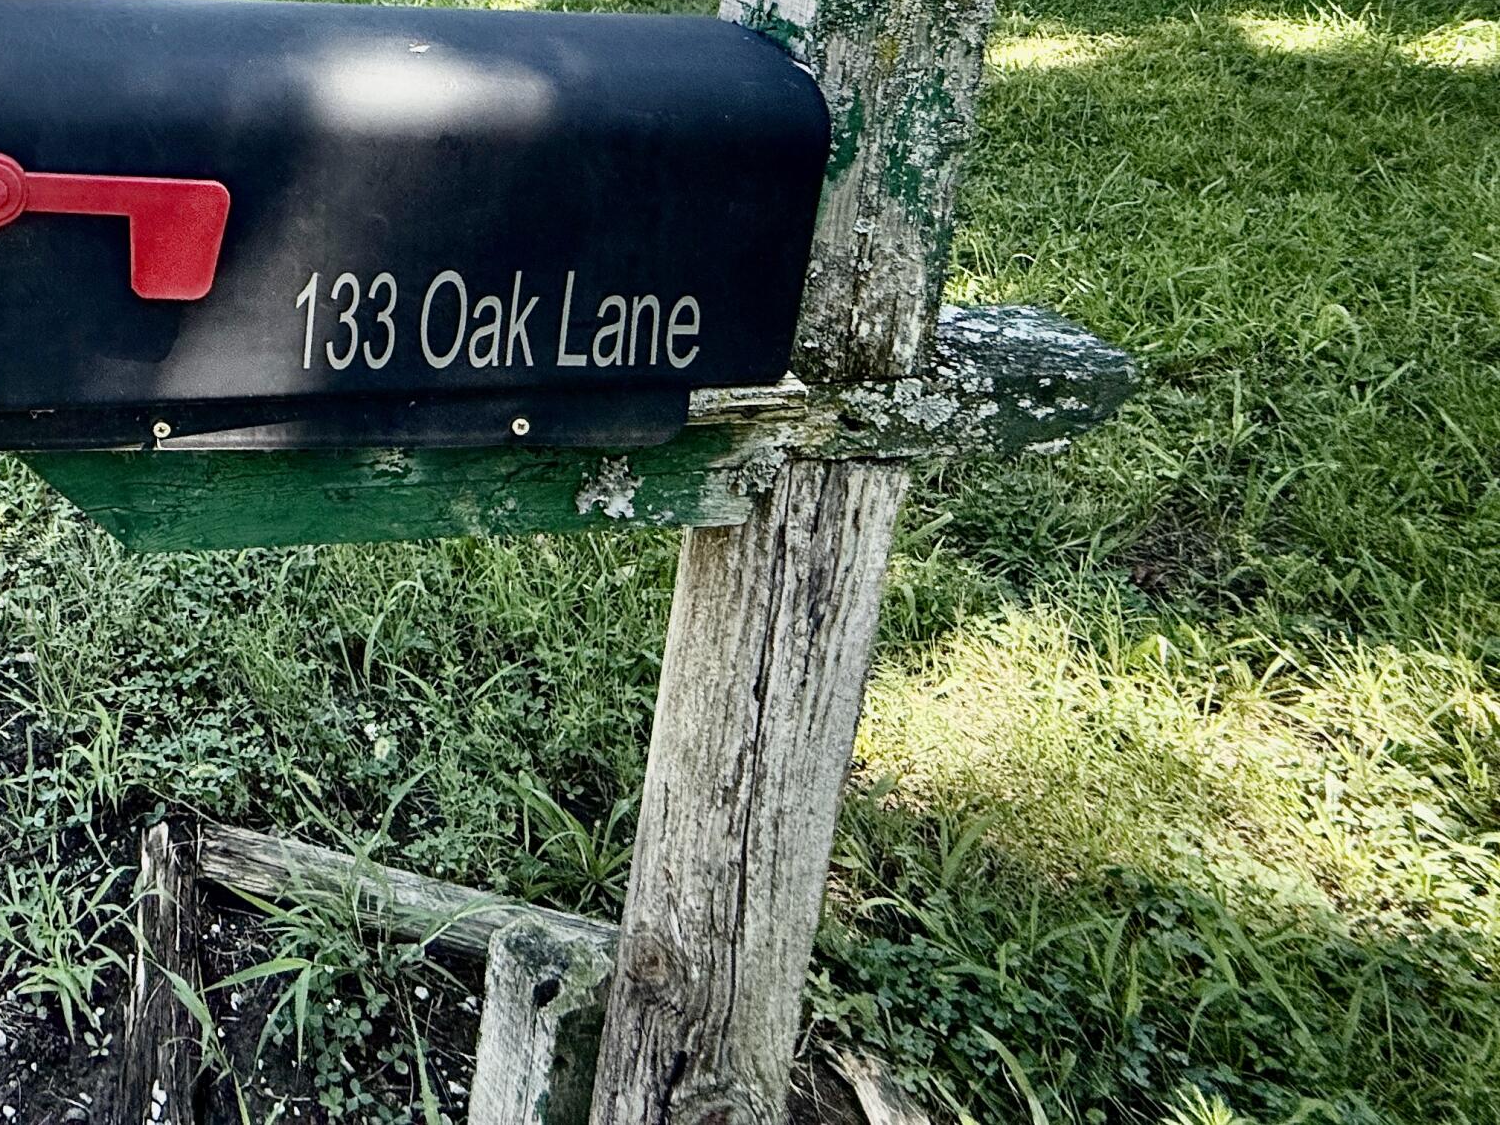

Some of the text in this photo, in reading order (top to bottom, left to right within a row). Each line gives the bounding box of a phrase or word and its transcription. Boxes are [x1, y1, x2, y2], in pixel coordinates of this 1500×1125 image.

[295, 270, 701, 370] 133 Oak Lane
